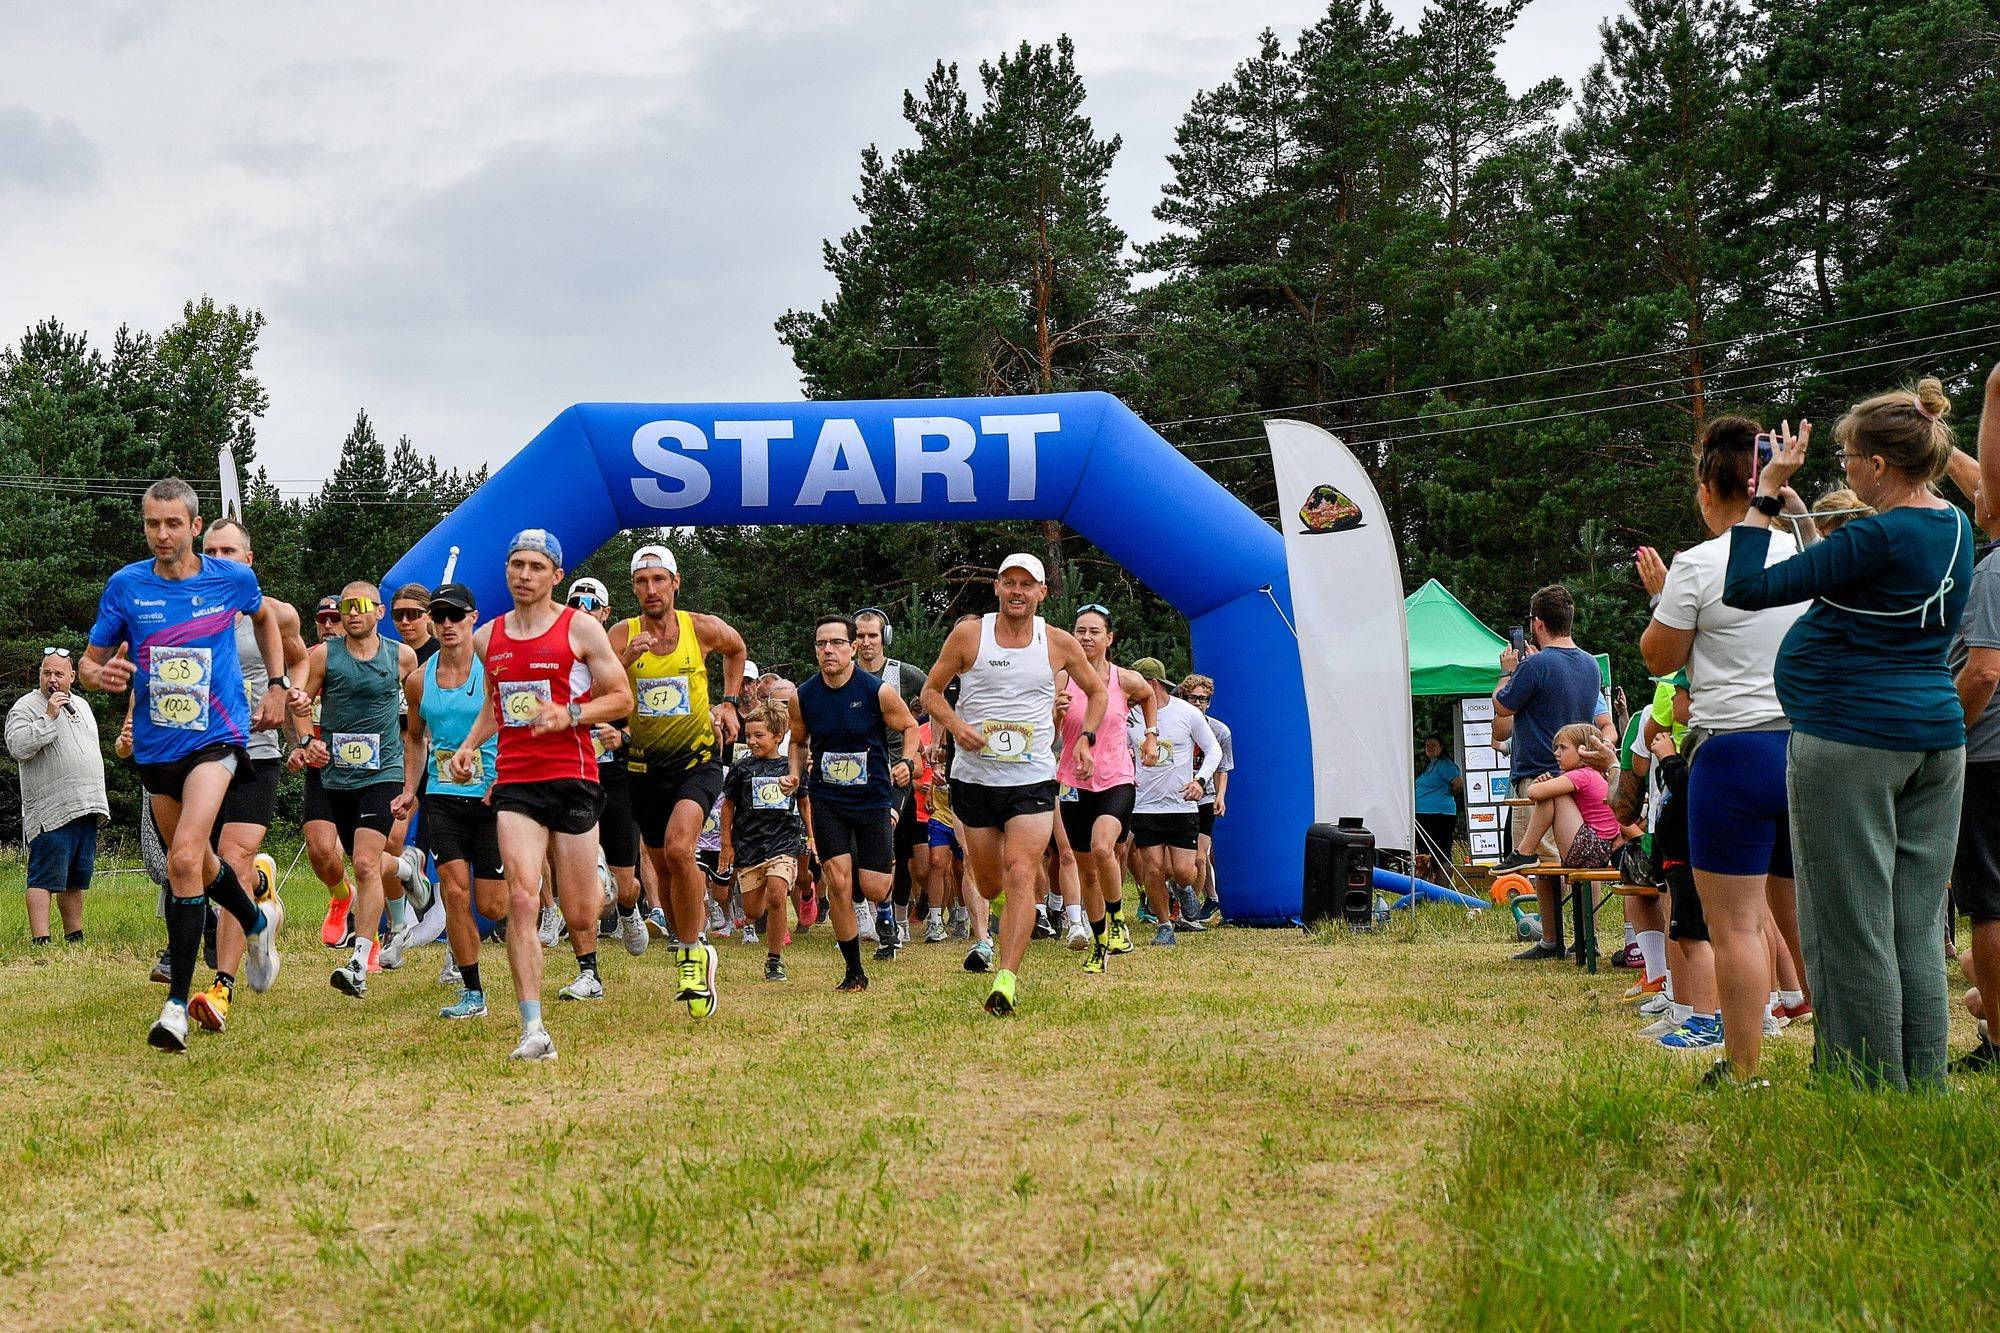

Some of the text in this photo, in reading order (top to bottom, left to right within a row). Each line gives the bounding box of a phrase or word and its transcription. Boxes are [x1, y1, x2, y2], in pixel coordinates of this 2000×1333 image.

[630, 412, 1062, 509] START
[168, 659, 191, 680] 38
[164, 698, 192, 712] 1002
[511, 696, 530, 714] 66
[652, 690, 668, 706] 57
[998, 731, 1012, 751] 9
[348, 744, 361, 759] 49
[761, 785, 779, 800] 69
